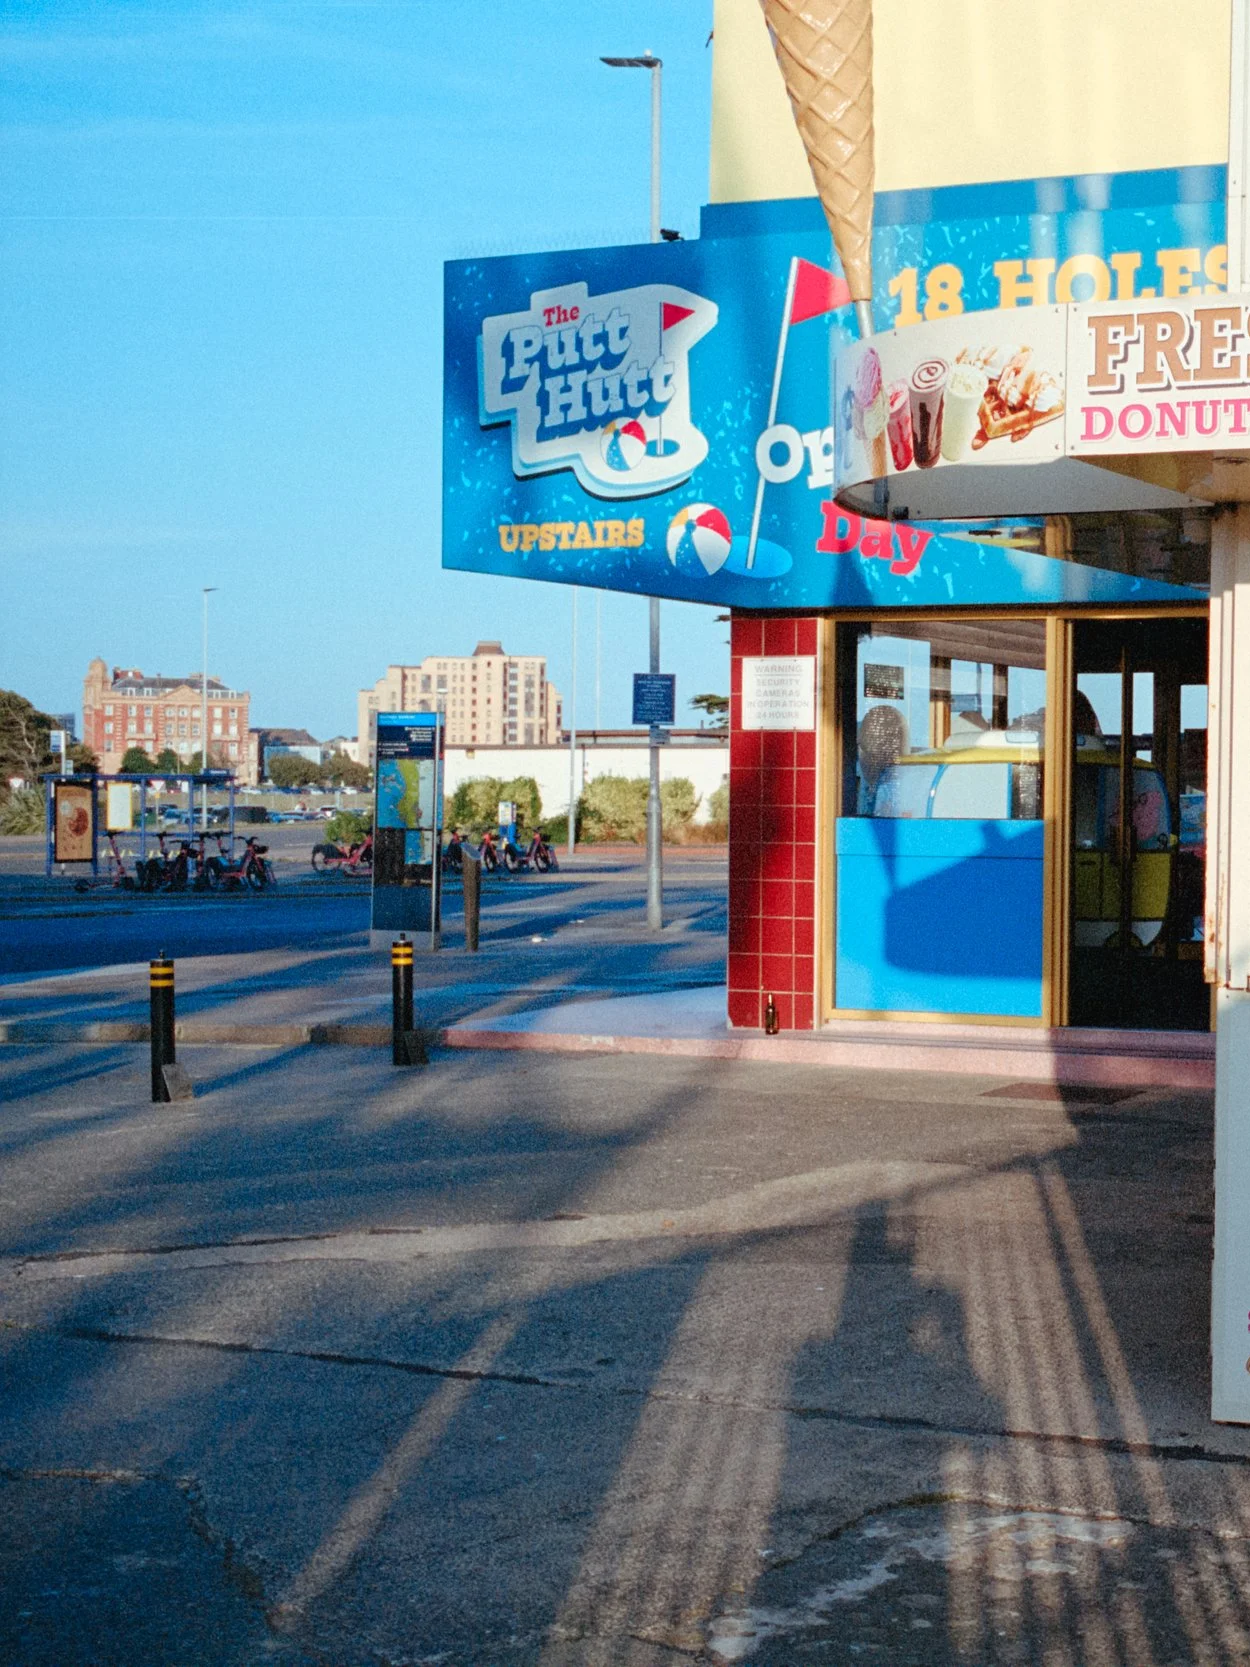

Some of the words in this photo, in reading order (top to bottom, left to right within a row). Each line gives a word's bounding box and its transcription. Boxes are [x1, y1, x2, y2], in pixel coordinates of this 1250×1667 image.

[888, 263, 964, 328] 18
[543, 305, 580, 327] The
[502, 307, 632, 388] Putt
[538, 356, 676, 432] Hutt
[755, 424, 835, 490] Op
[498, 518, 645, 553] UPSTAIRS
[815, 500, 934, 576] Day
[754, 664, 804, 673] WARNING
[755, 678, 801, 687] SECURITY
[755, 689, 801, 698] CAMERAS
[756, 700, 810, 709] OPERATION
[756, 711, 767, 720] 24
[768, 711, 801, 720] HOURS
